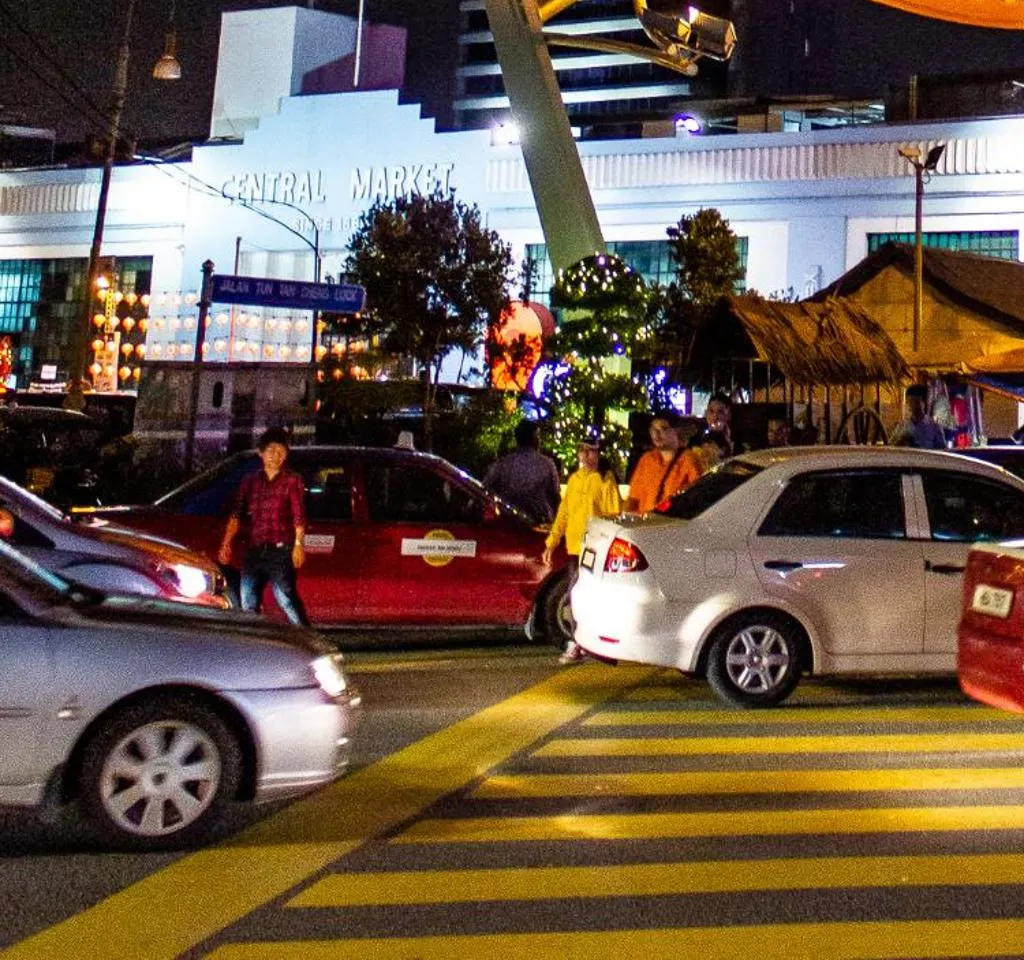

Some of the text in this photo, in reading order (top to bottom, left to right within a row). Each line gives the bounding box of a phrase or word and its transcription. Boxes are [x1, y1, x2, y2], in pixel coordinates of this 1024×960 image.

[222, 162, 455, 204] CENTRAL MARKET
[219, 279, 249, 293] JALAN
